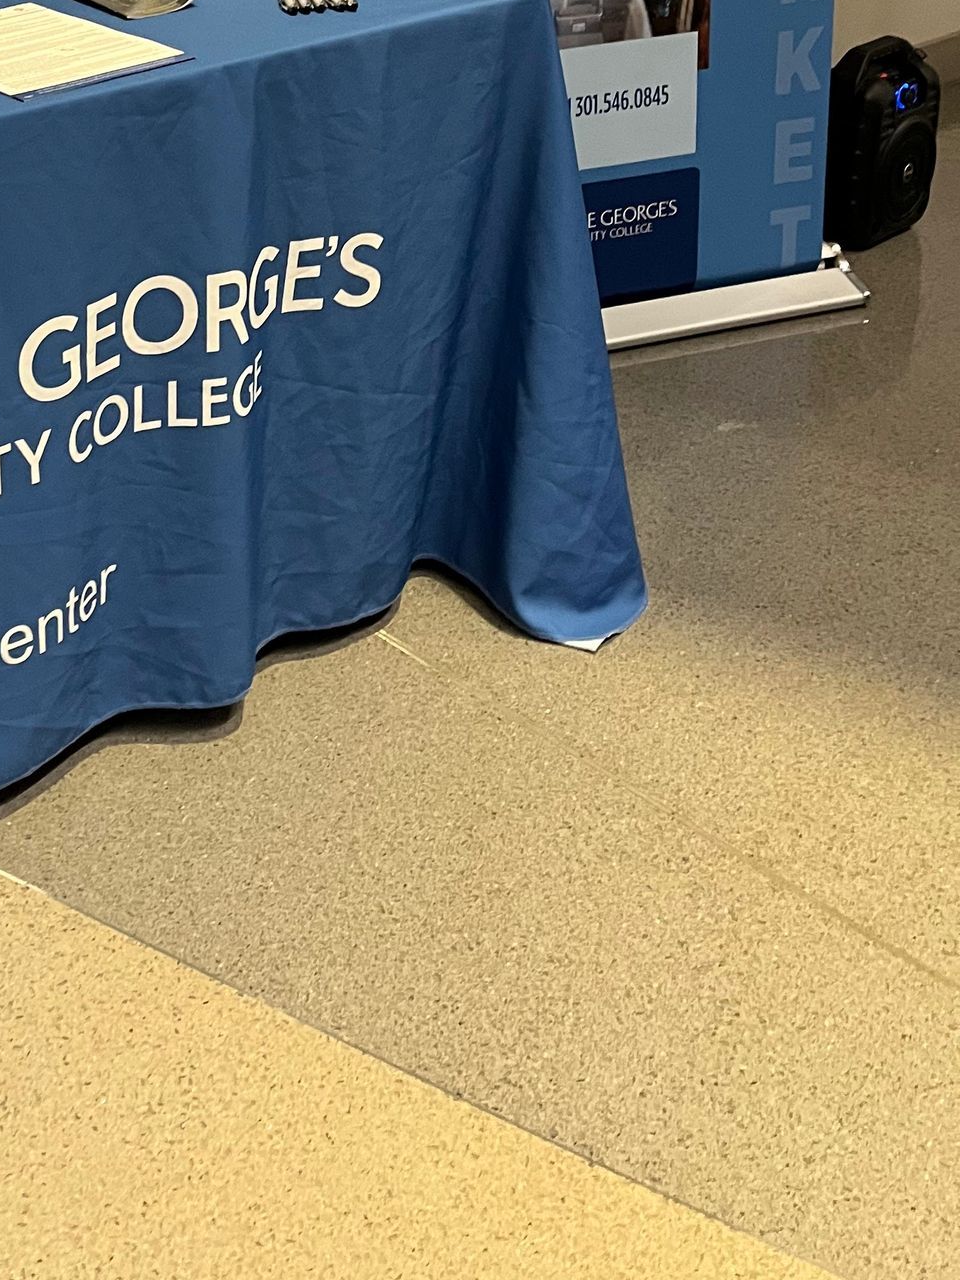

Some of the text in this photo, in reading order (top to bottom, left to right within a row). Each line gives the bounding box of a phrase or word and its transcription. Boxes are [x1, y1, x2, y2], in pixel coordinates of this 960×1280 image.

[600, 199, 678, 226] GEORGE'S
[609, 223, 654, 239] COLLEGE
[17, 231, 384, 403] GEORGE'S
[68, 349, 264, 465] COLLEGE
